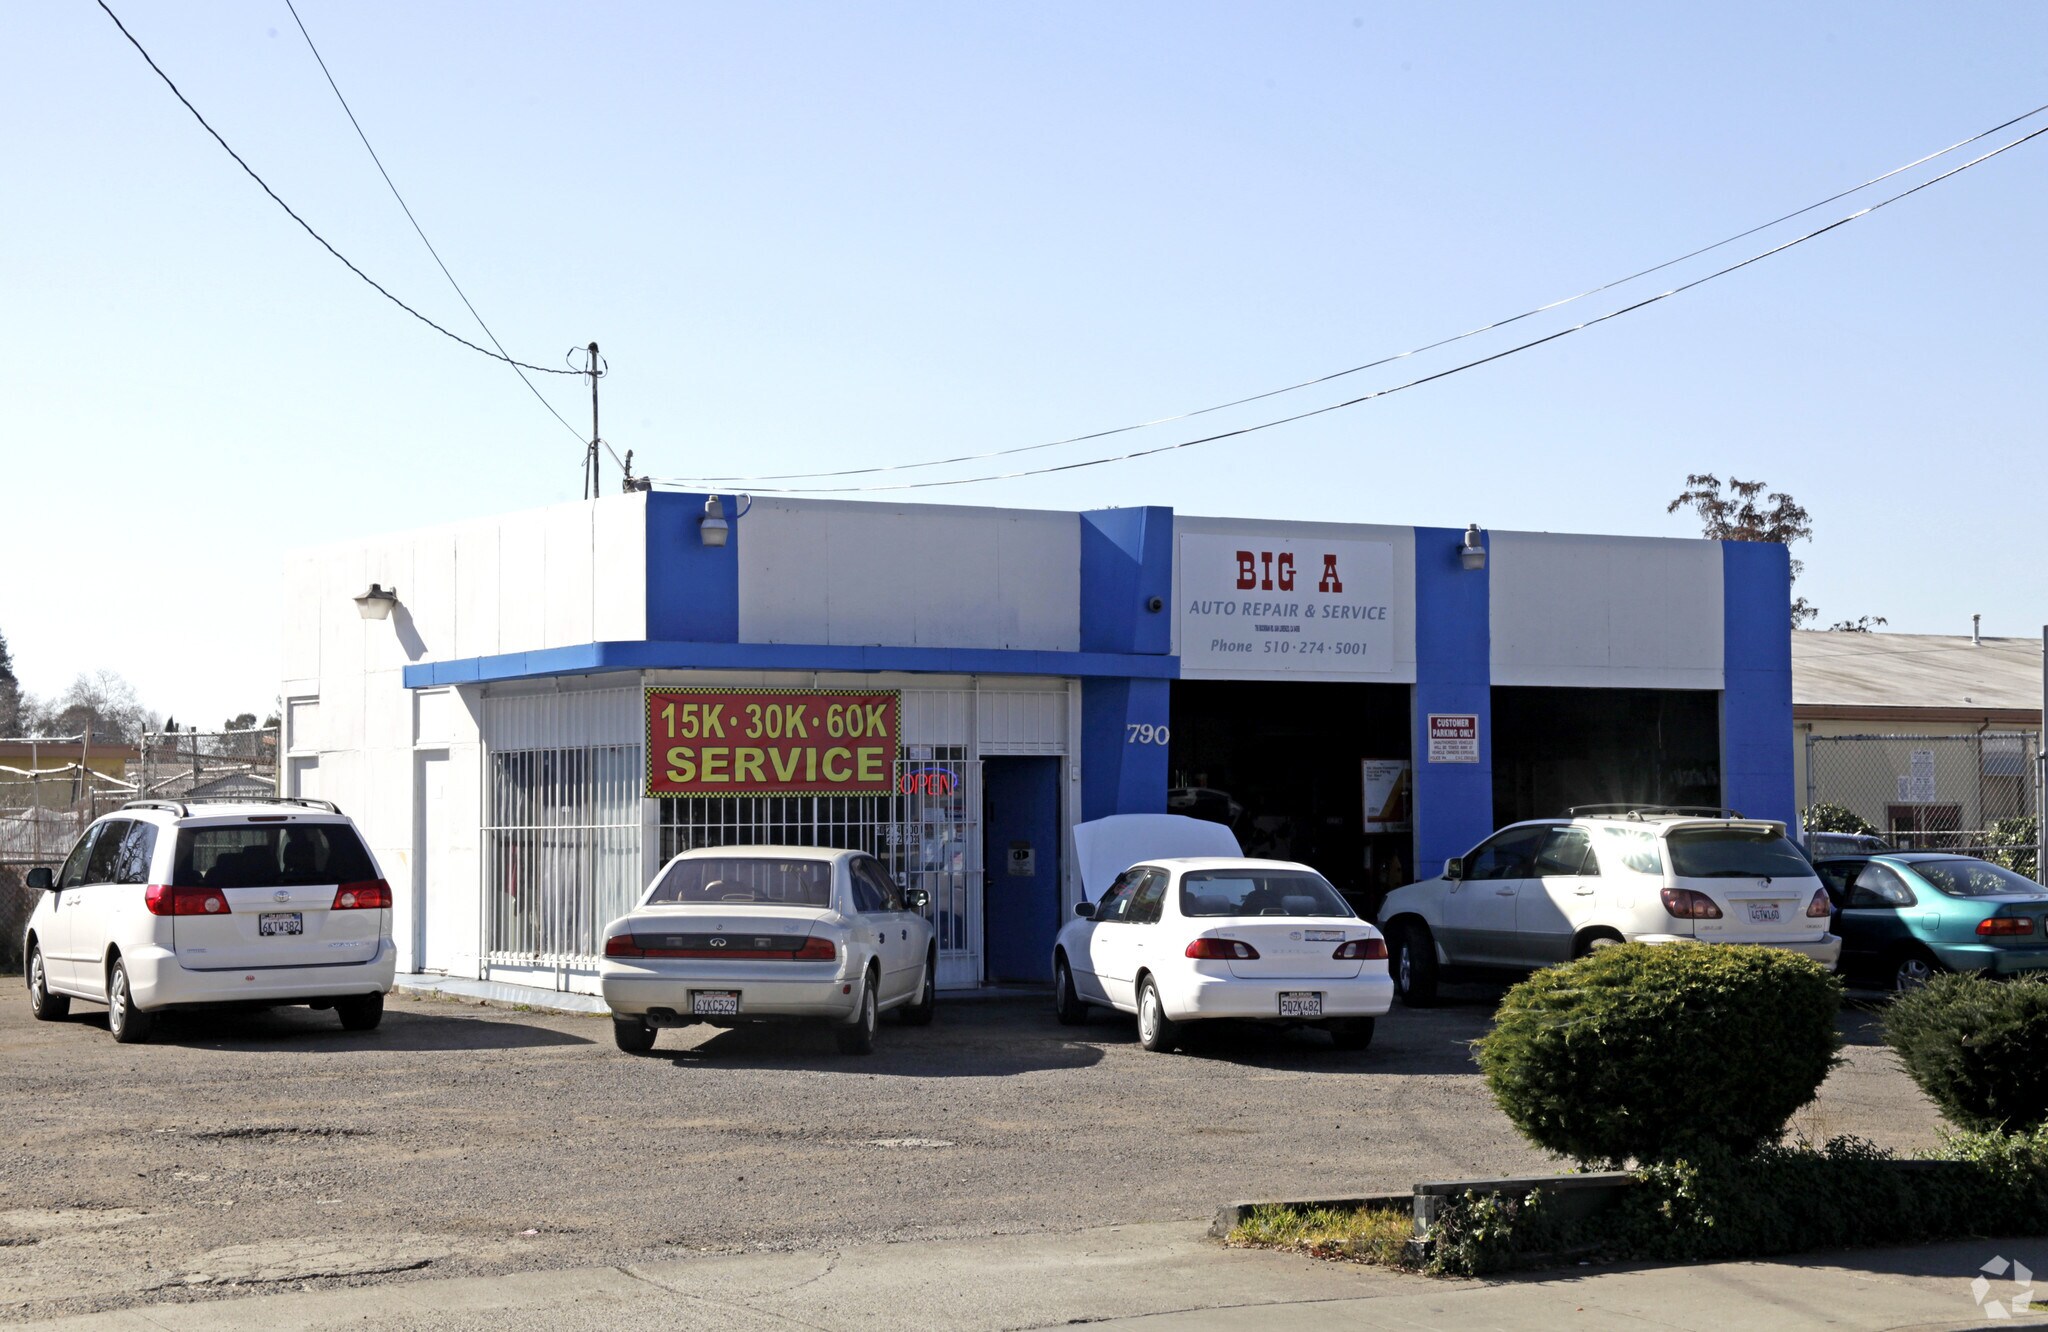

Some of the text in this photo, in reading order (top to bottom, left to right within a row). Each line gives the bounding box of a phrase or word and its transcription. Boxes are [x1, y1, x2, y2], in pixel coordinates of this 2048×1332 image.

[1236, 550, 1343, 593] BIG A
[1189, 600, 1387, 620] AUTO REPAIR & SERVICE
[1210, 638, 1253, 653] Phone
[1436, 718, 1469, 728] CUSTOMER
[1126, 723, 1171, 746] 790
[1432, 729, 1474, 738] PARKING ONLY
[665, 746, 885, 783] SERVICE
[900, 773, 953, 796] OPEN
[262, 920, 300, 932] 6KTW382
[695, 999, 736, 1011] 6YKC529
